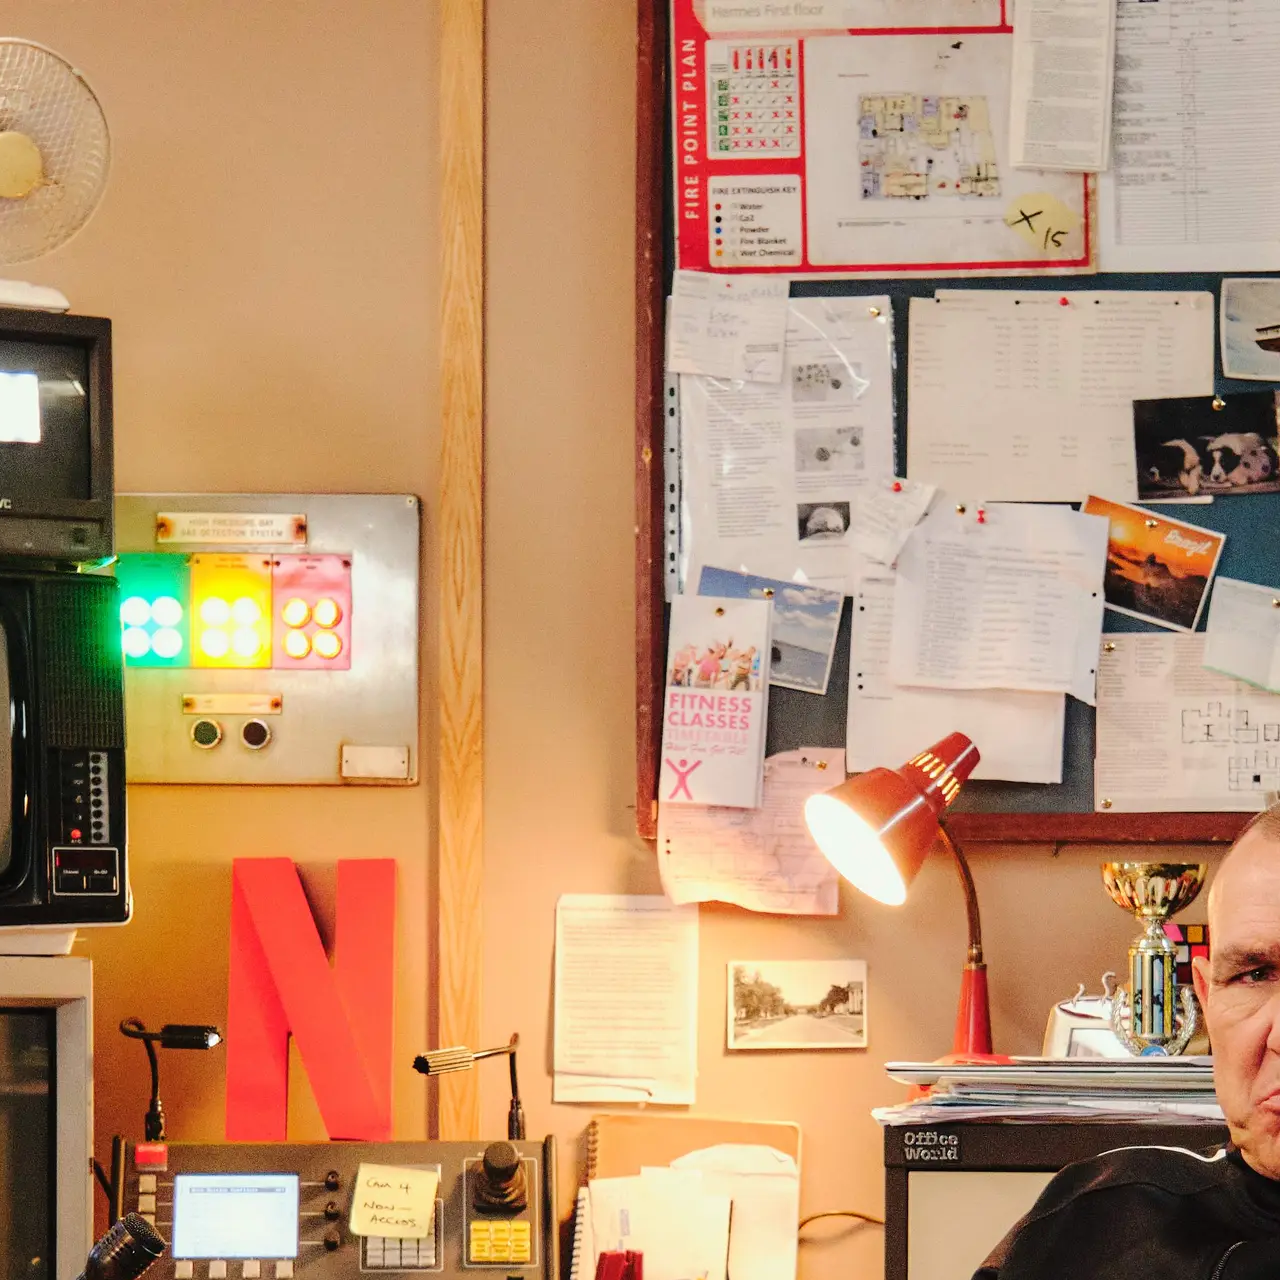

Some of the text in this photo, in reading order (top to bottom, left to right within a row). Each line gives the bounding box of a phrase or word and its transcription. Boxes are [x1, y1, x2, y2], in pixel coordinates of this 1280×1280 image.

[681, 39, 700, 220] FIRE POINT PLAN
[1043, 226, 1069, 250] 15
[669, 692, 752, 714] FITNESS
[668, 711, 750, 731] CLASSES
[226, 856, 399, 1141] N
[904, 1131, 959, 1146] Office
[904, 1146, 958, 1160] World
[399, 1183, 411, 1194] 4
